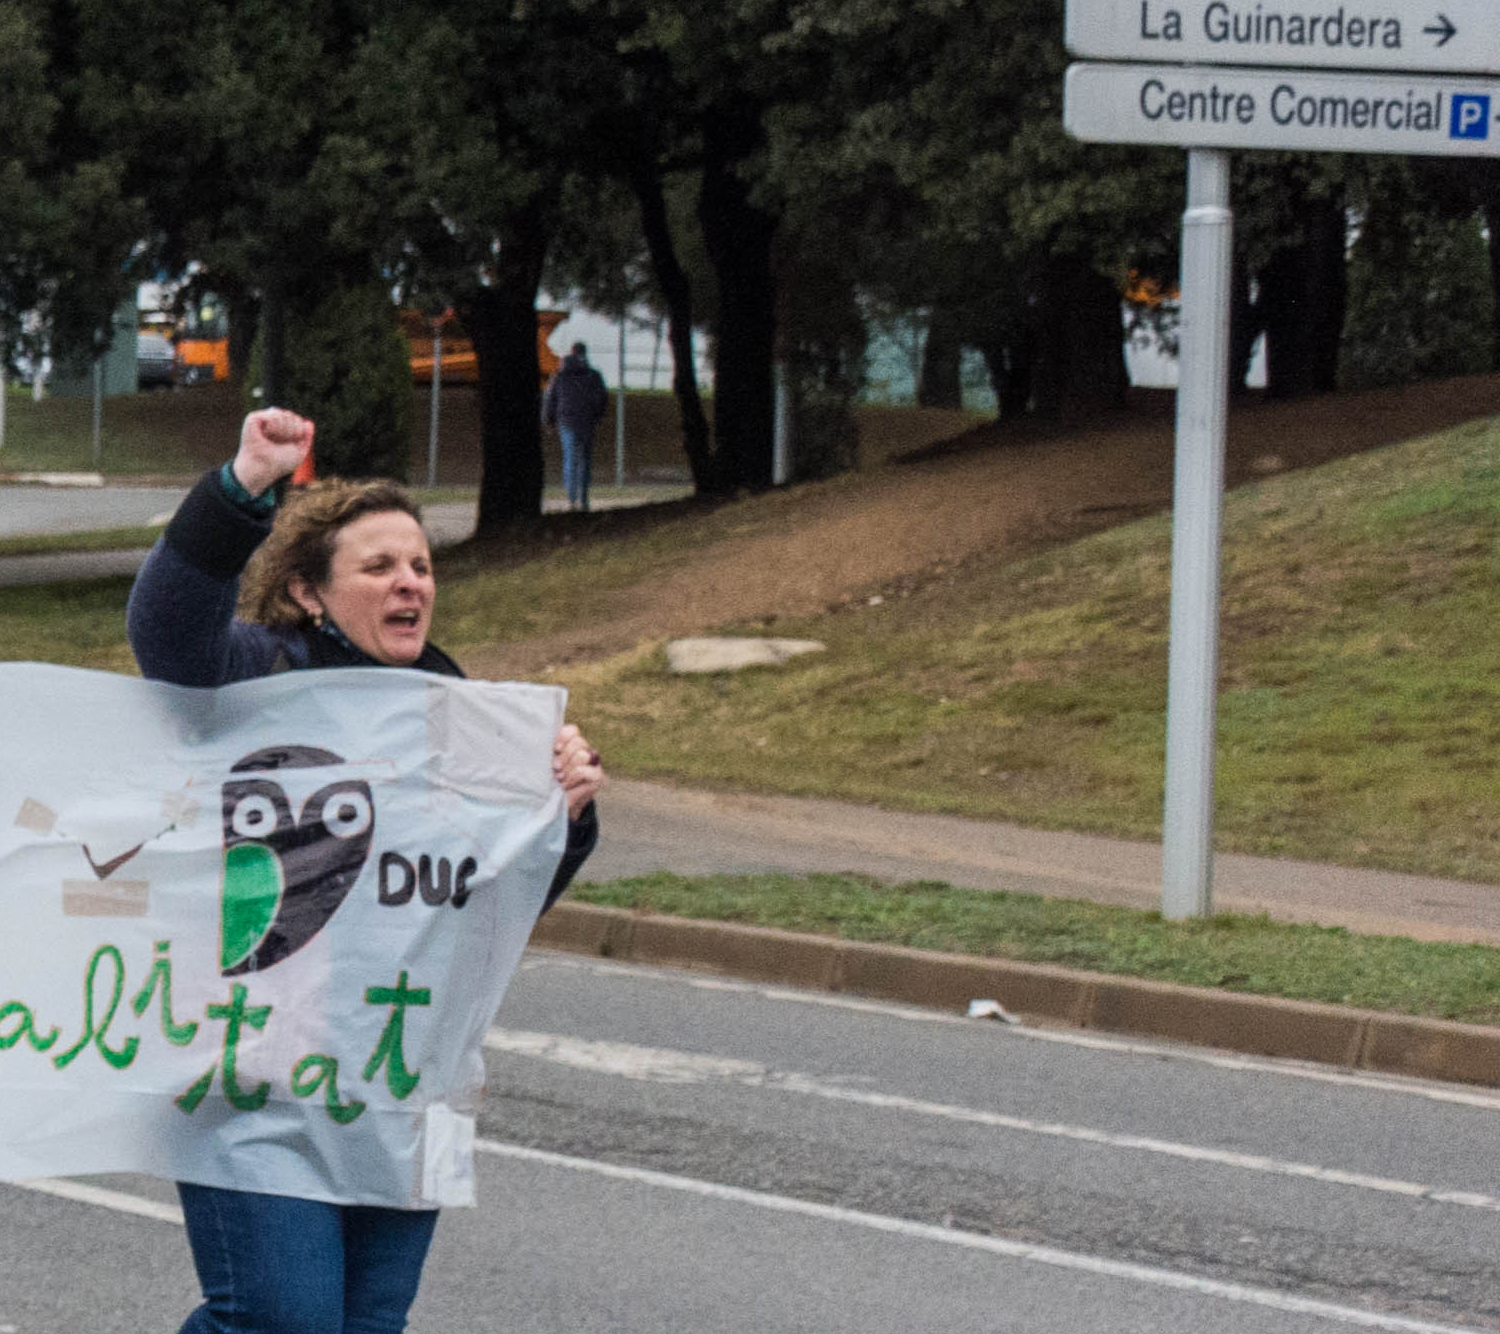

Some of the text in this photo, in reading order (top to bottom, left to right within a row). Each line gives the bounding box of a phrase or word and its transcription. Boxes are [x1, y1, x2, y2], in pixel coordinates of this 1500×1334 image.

[1139, 0, 1402, 49] La Guinardera
[1139, 78, 1483, 135] Centre Comercial P
